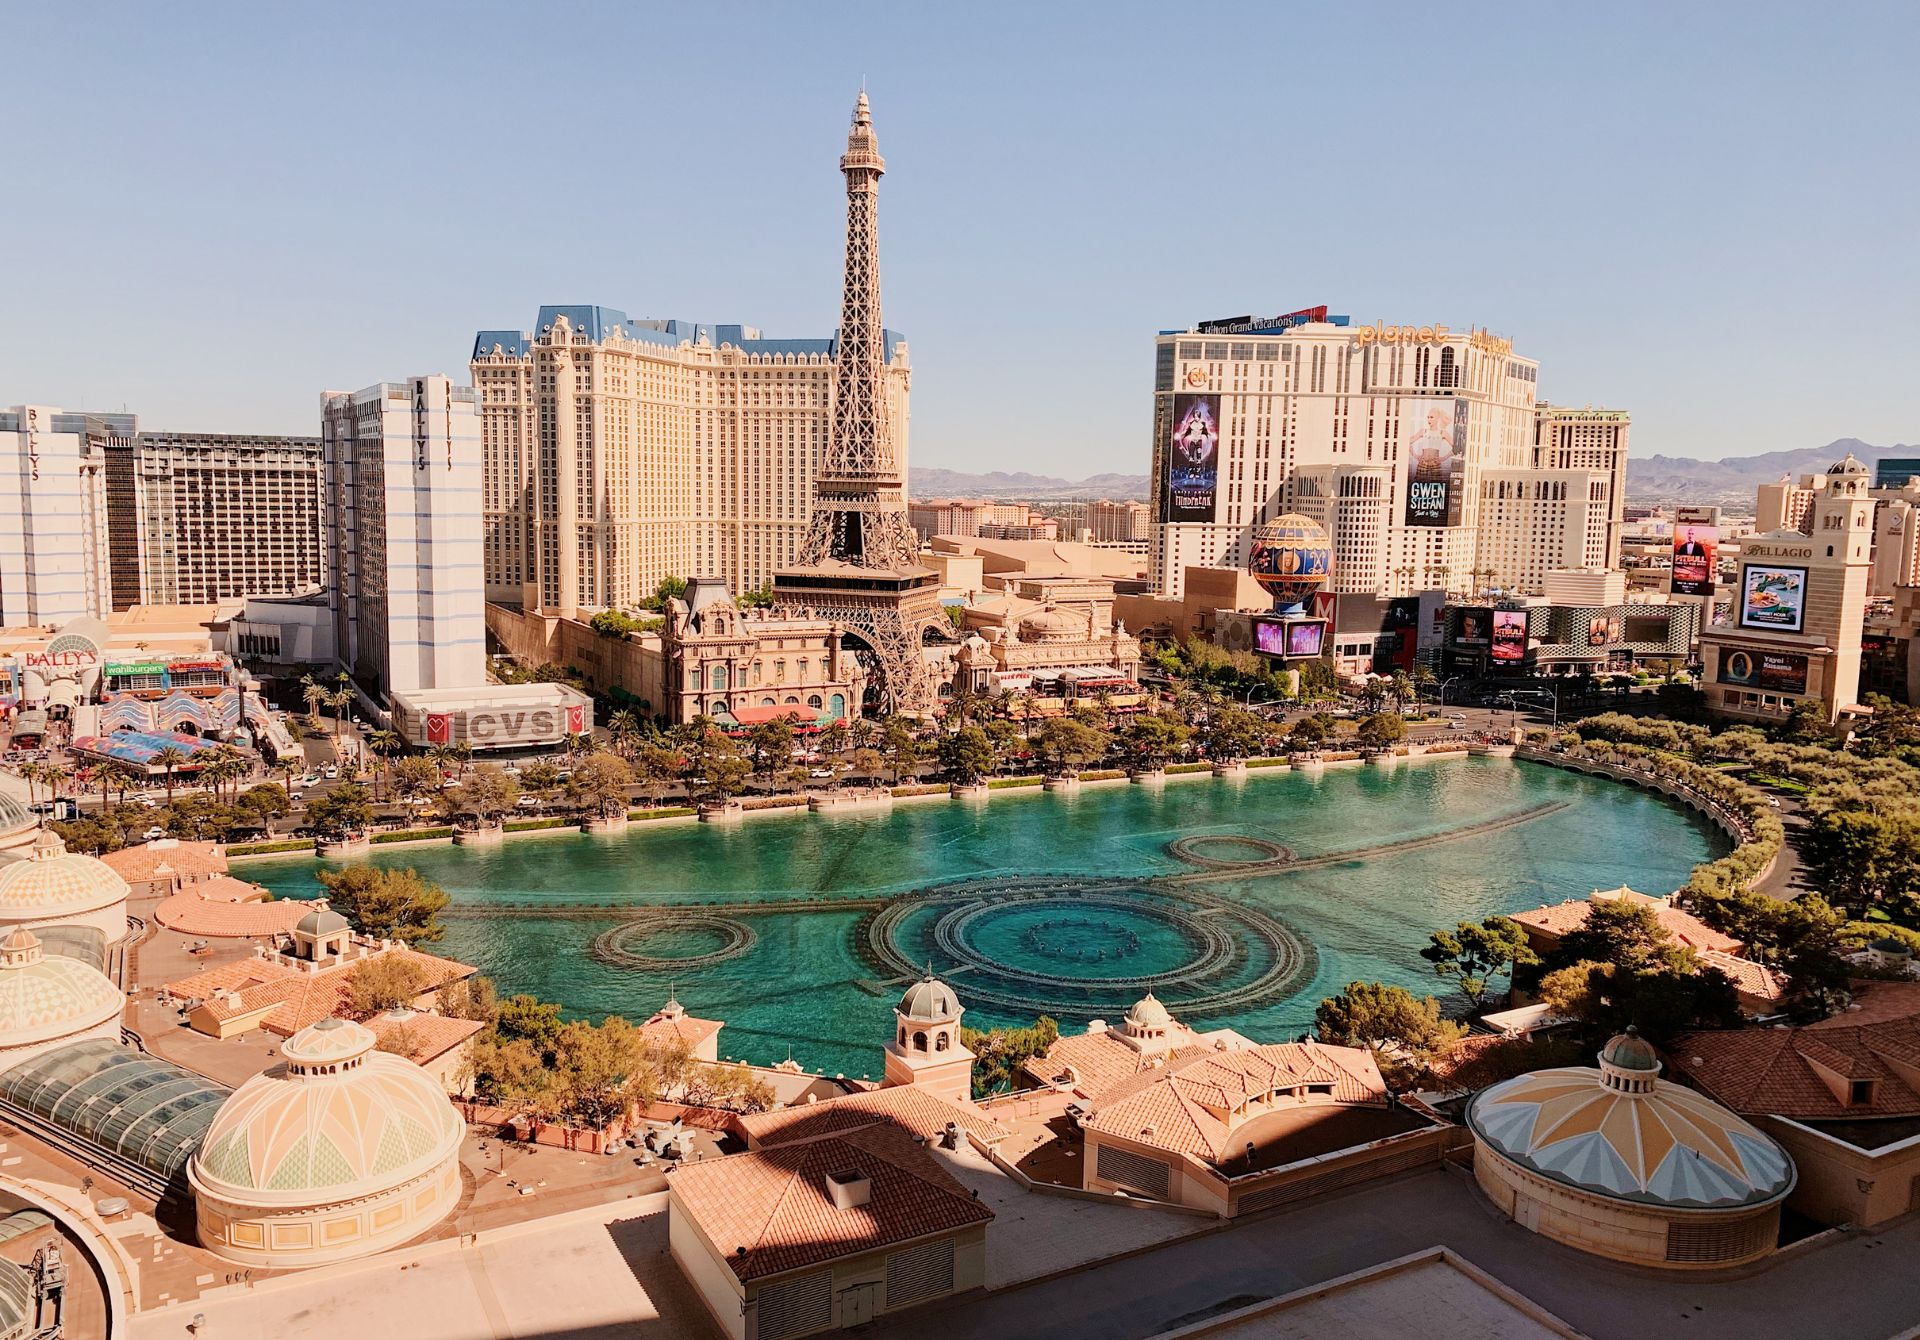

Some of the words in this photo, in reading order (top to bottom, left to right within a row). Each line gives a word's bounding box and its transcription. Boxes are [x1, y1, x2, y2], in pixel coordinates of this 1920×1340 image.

[1205, 322, 1228, 335] Hilton
[1229, 321, 1252, 333] Grand
[1253, 316, 1293, 331] Vacations
[1359, 319, 1449, 347] planet
[1411, 482, 1446, 498] GWEN
[1410, 498, 1445, 509] STEFANI
[1743, 545, 1812, 558] BELLAGIO
[1316, 597, 1335, 624] M
[108, 665, 163, 674] wahlburgers
[1727, 651, 1753, 680] O
[470, 711, 554, 740] CVS
